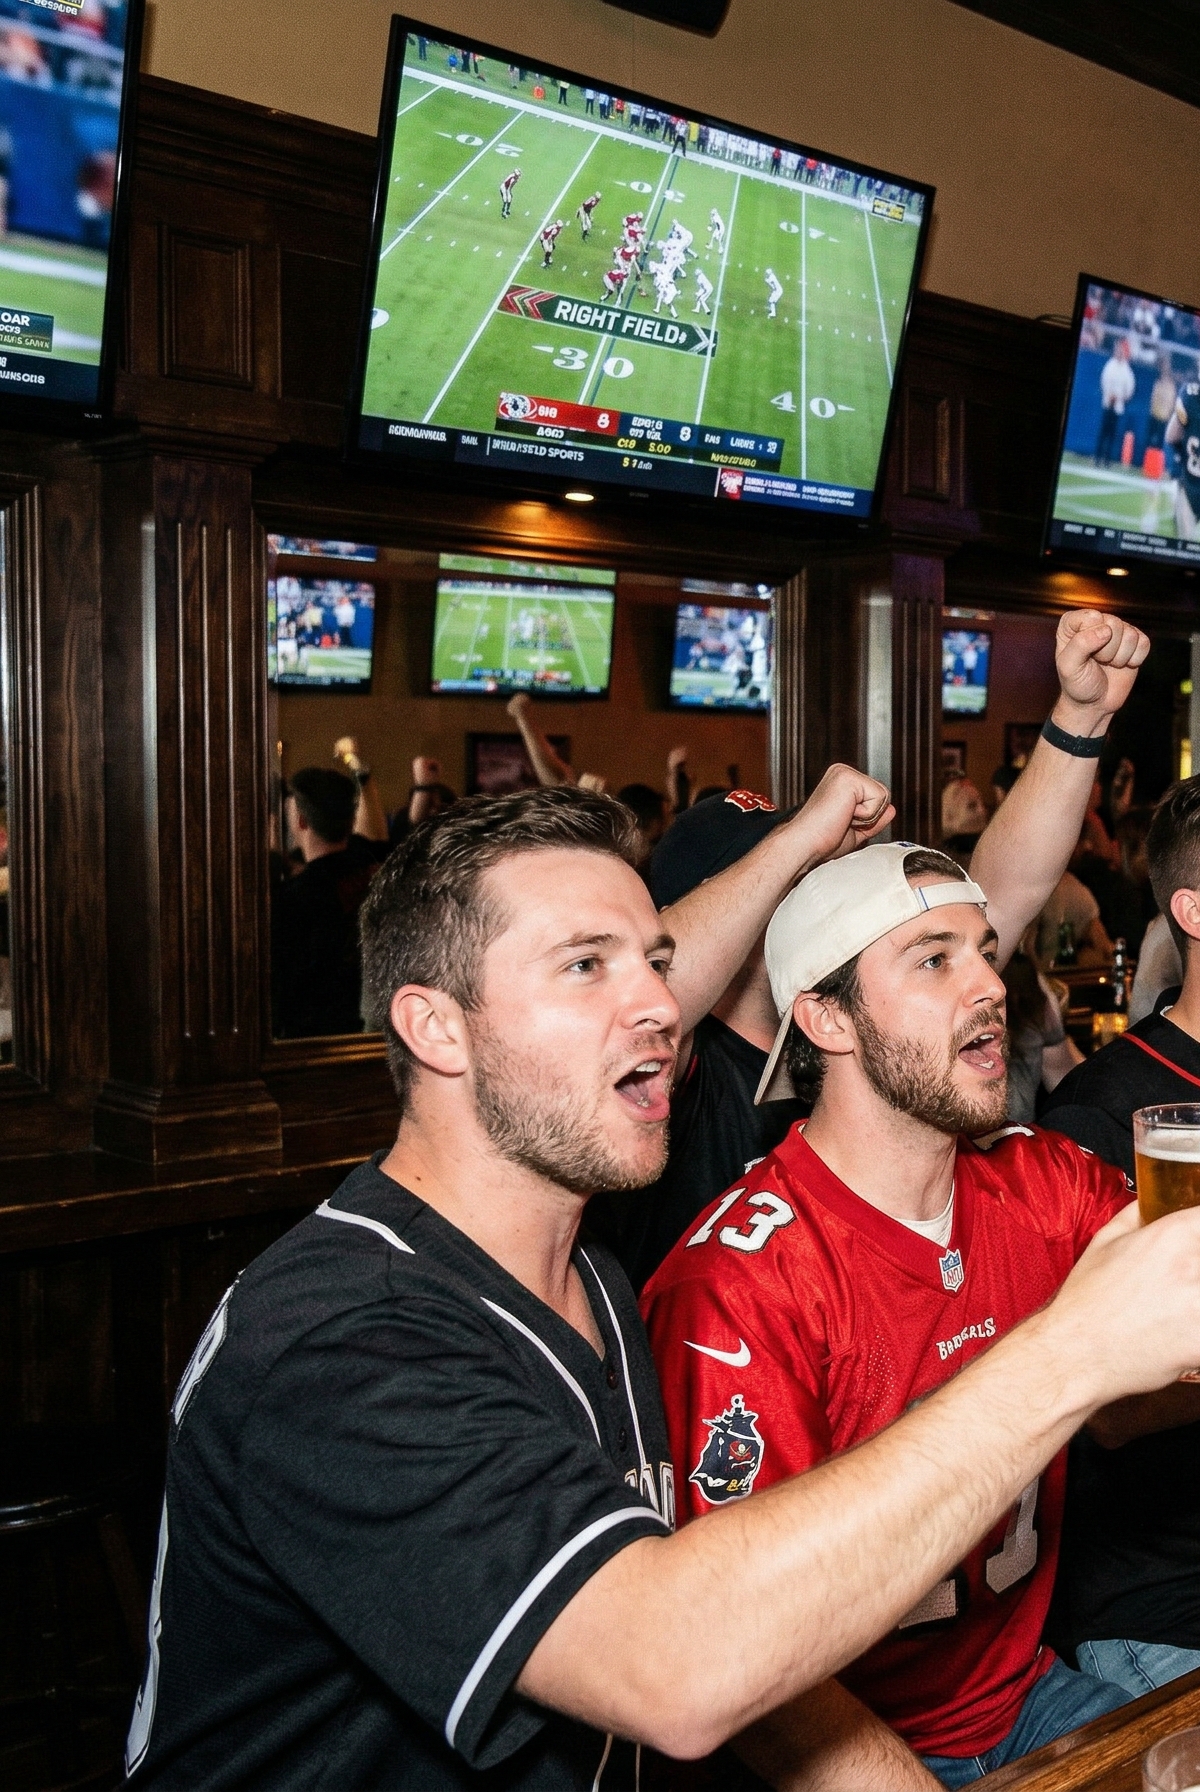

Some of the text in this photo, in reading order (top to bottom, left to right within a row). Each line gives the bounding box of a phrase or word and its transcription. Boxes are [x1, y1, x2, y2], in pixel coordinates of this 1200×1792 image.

[554, 300, 680, 345] RIGHT FIELD
[684, 1186, 797, 1255] 13
